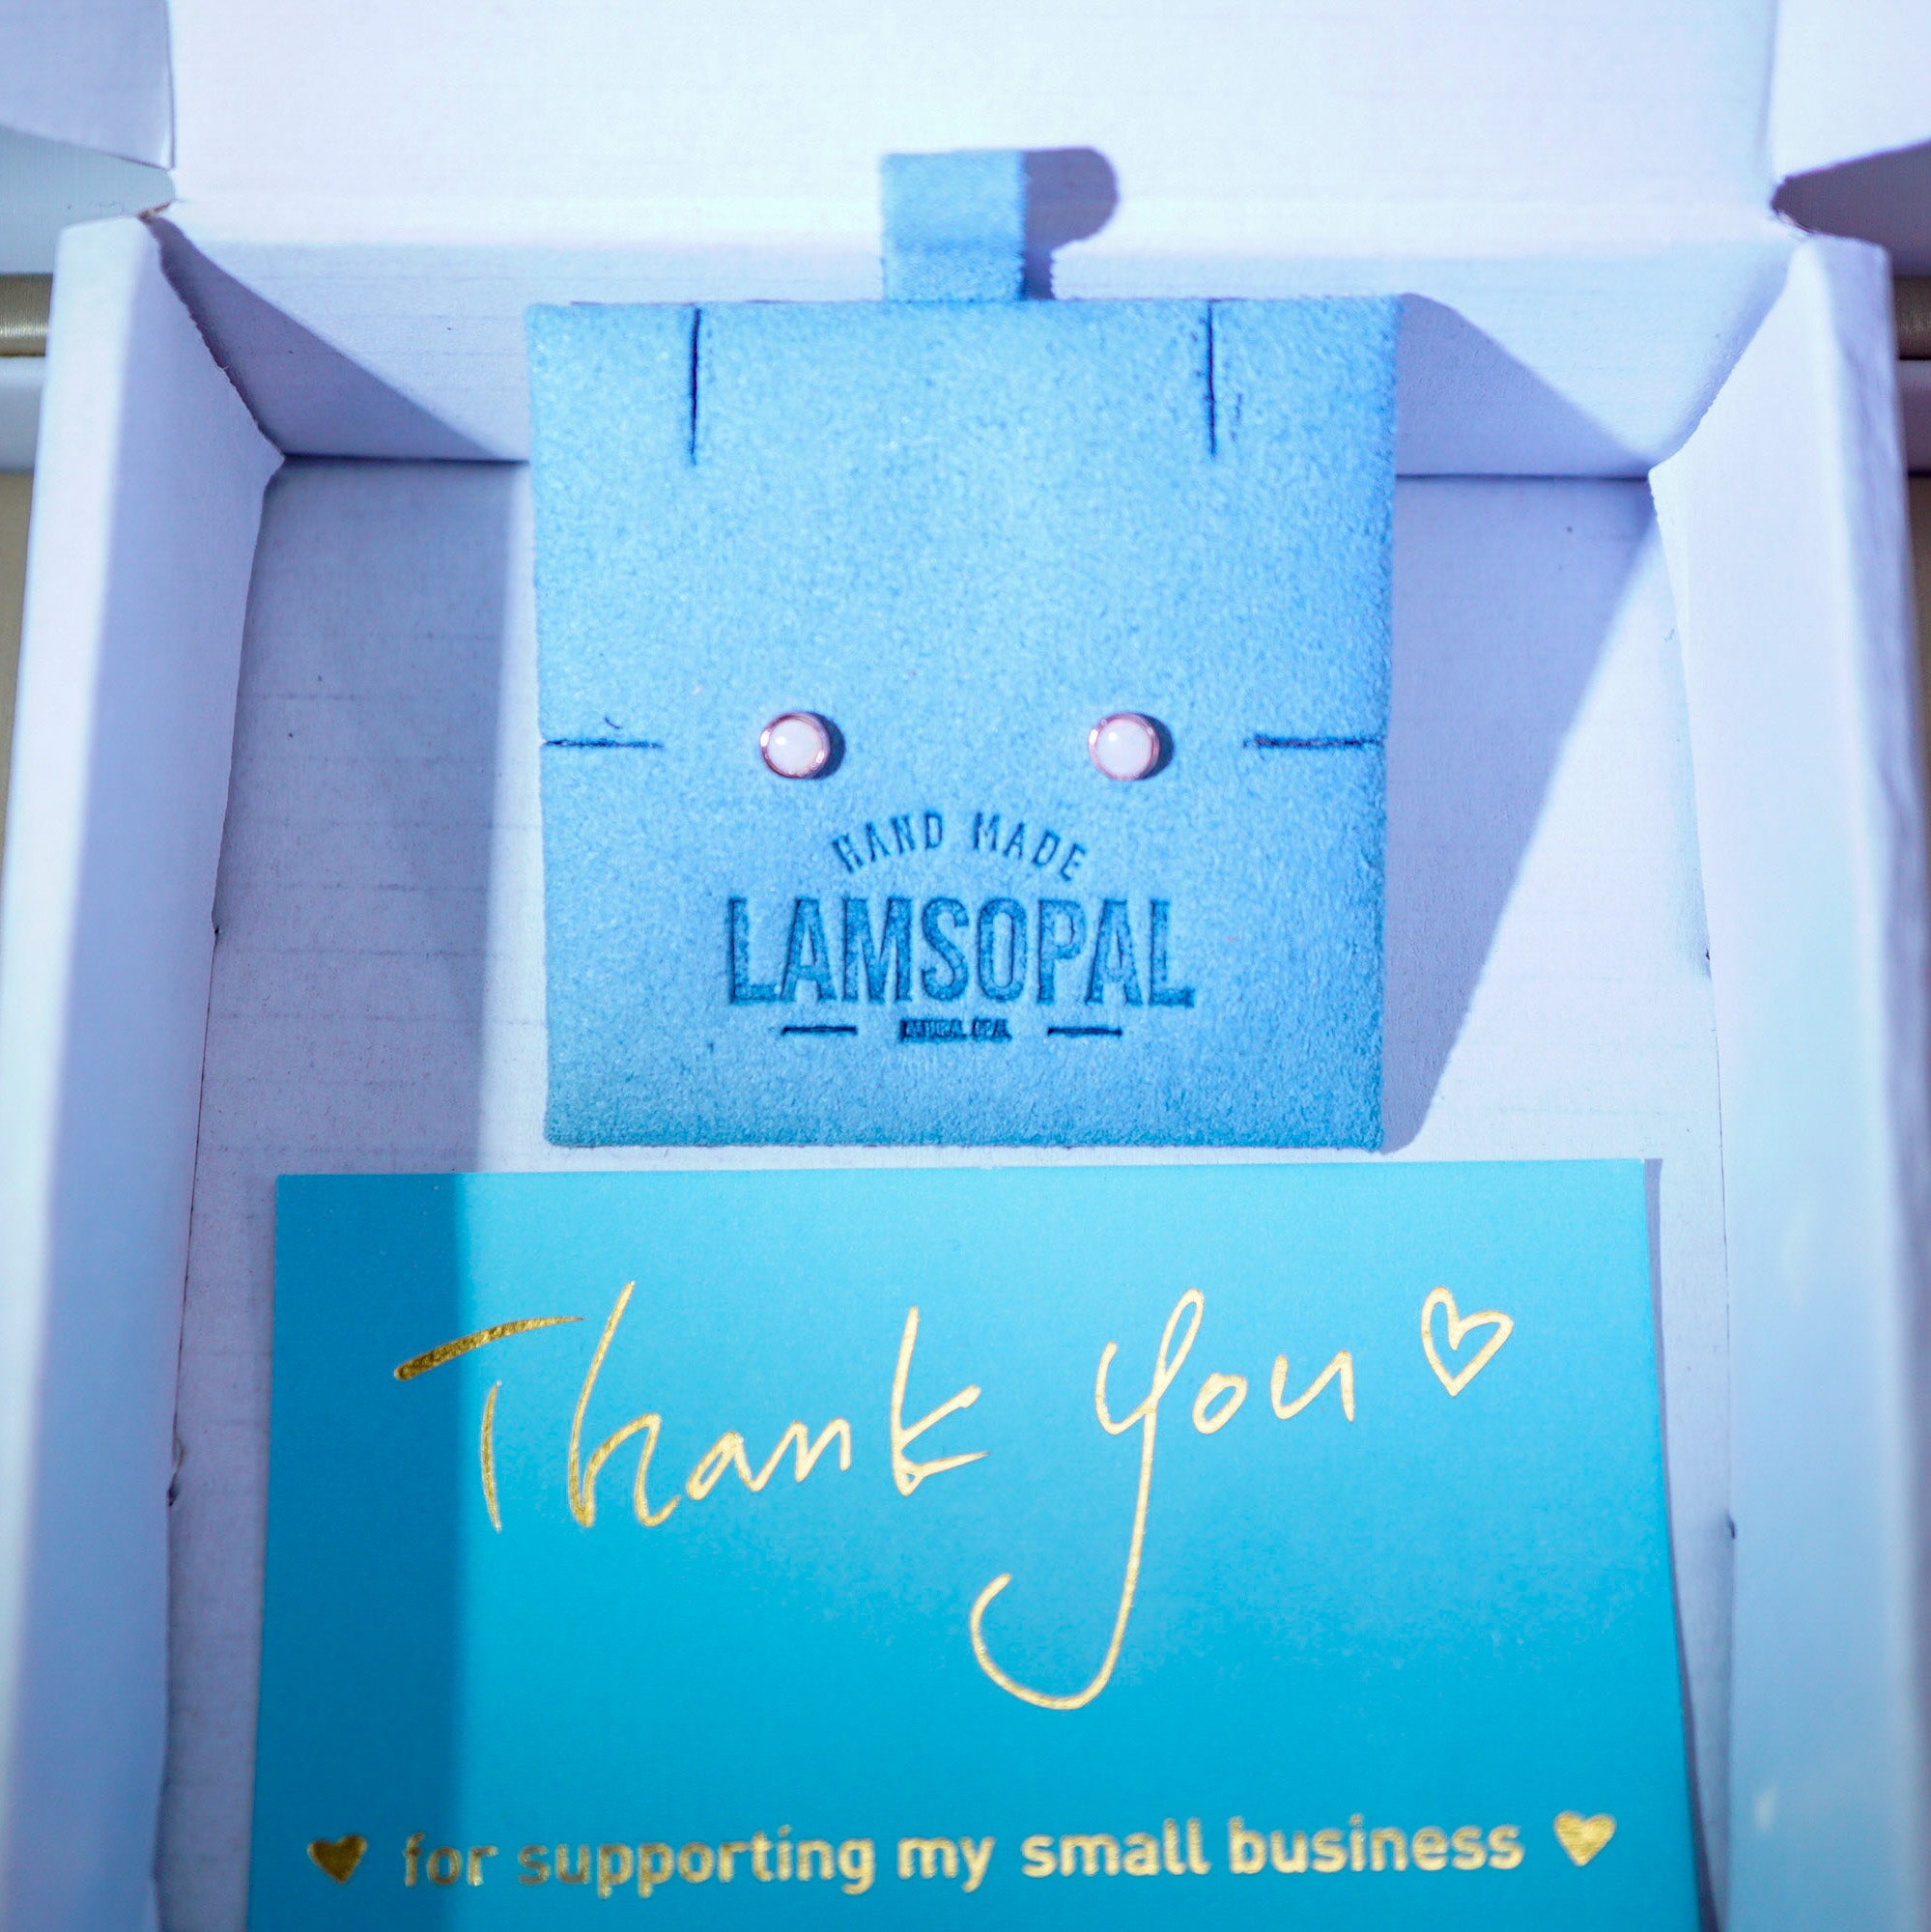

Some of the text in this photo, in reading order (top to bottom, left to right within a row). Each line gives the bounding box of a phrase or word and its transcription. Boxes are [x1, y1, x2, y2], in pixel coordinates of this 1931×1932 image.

[832, 810, 1087, 882] HAND MADE
[727, 895, 1195, 1006] LAMSOPAL
[392, 1281, 989, 1530] Thank
[403, 1812, 1525, 1898] for supporting my small business
